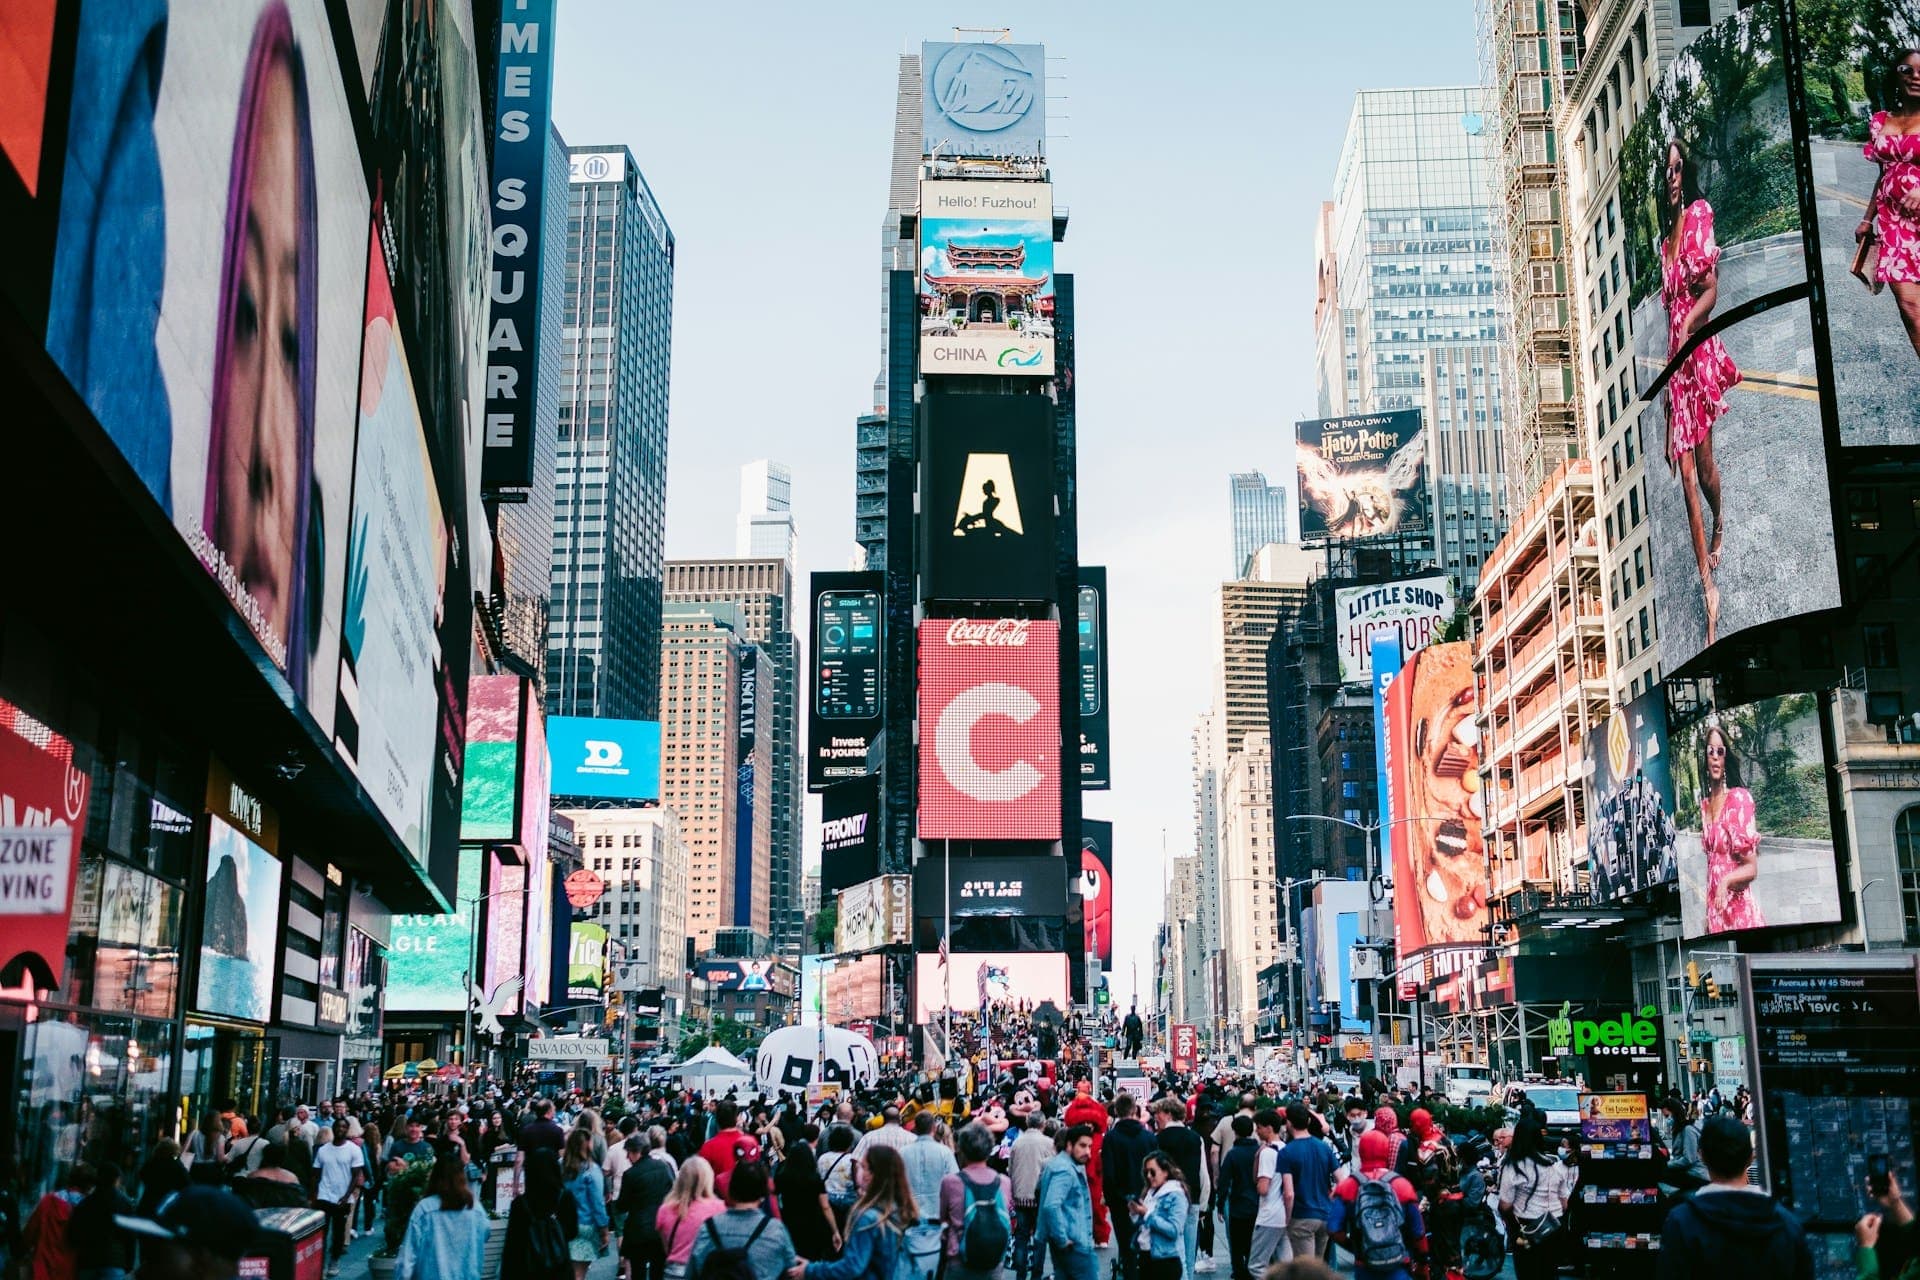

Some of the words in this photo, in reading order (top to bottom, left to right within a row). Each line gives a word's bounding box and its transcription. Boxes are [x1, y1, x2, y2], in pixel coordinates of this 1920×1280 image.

[938, 195, 977, 208] Hello!
[982, 196, 1037, 209] Fuzhou!
[486, 178, 529, 447] SQUARE
[933, 347, 987, 361] CHINA
[1323, 421, 1339, 430] ON
[1342, 416, 1393, 429] BROADWAY
[1321, 434, 1358, 460] Harry
[1358, 429, 1399, 458] Potter
[1349, 587, 1401, 620] LITTLE
[1404, 586, 1444, 611] SHOP
[946, 617, 1031, 646] Coca-Cola
[832, 736, 866, 747] Invest
[819, 747, 831, 758] in
[0, 838, 55, 866] ZONE
[1771, 979, 1777, 987] 7
[1778, 979, 1809, 987] Avenue
[1817, 979, 1827, 987] W
[1828, 979, 1839, 987] 45
[1839, 979, 1864, 987] Street
[1773, 993, 1797, 1001] Times
[1799, 993, 1828, 1002] Square
[1573, 1005, 1657, 1055] pelé
[1178, 1027, 1193, 1057] tkts
[530, 1043, 606, 1056] SWAROVSKI
[1593, 1046, 1647, 1055] SOCCER
